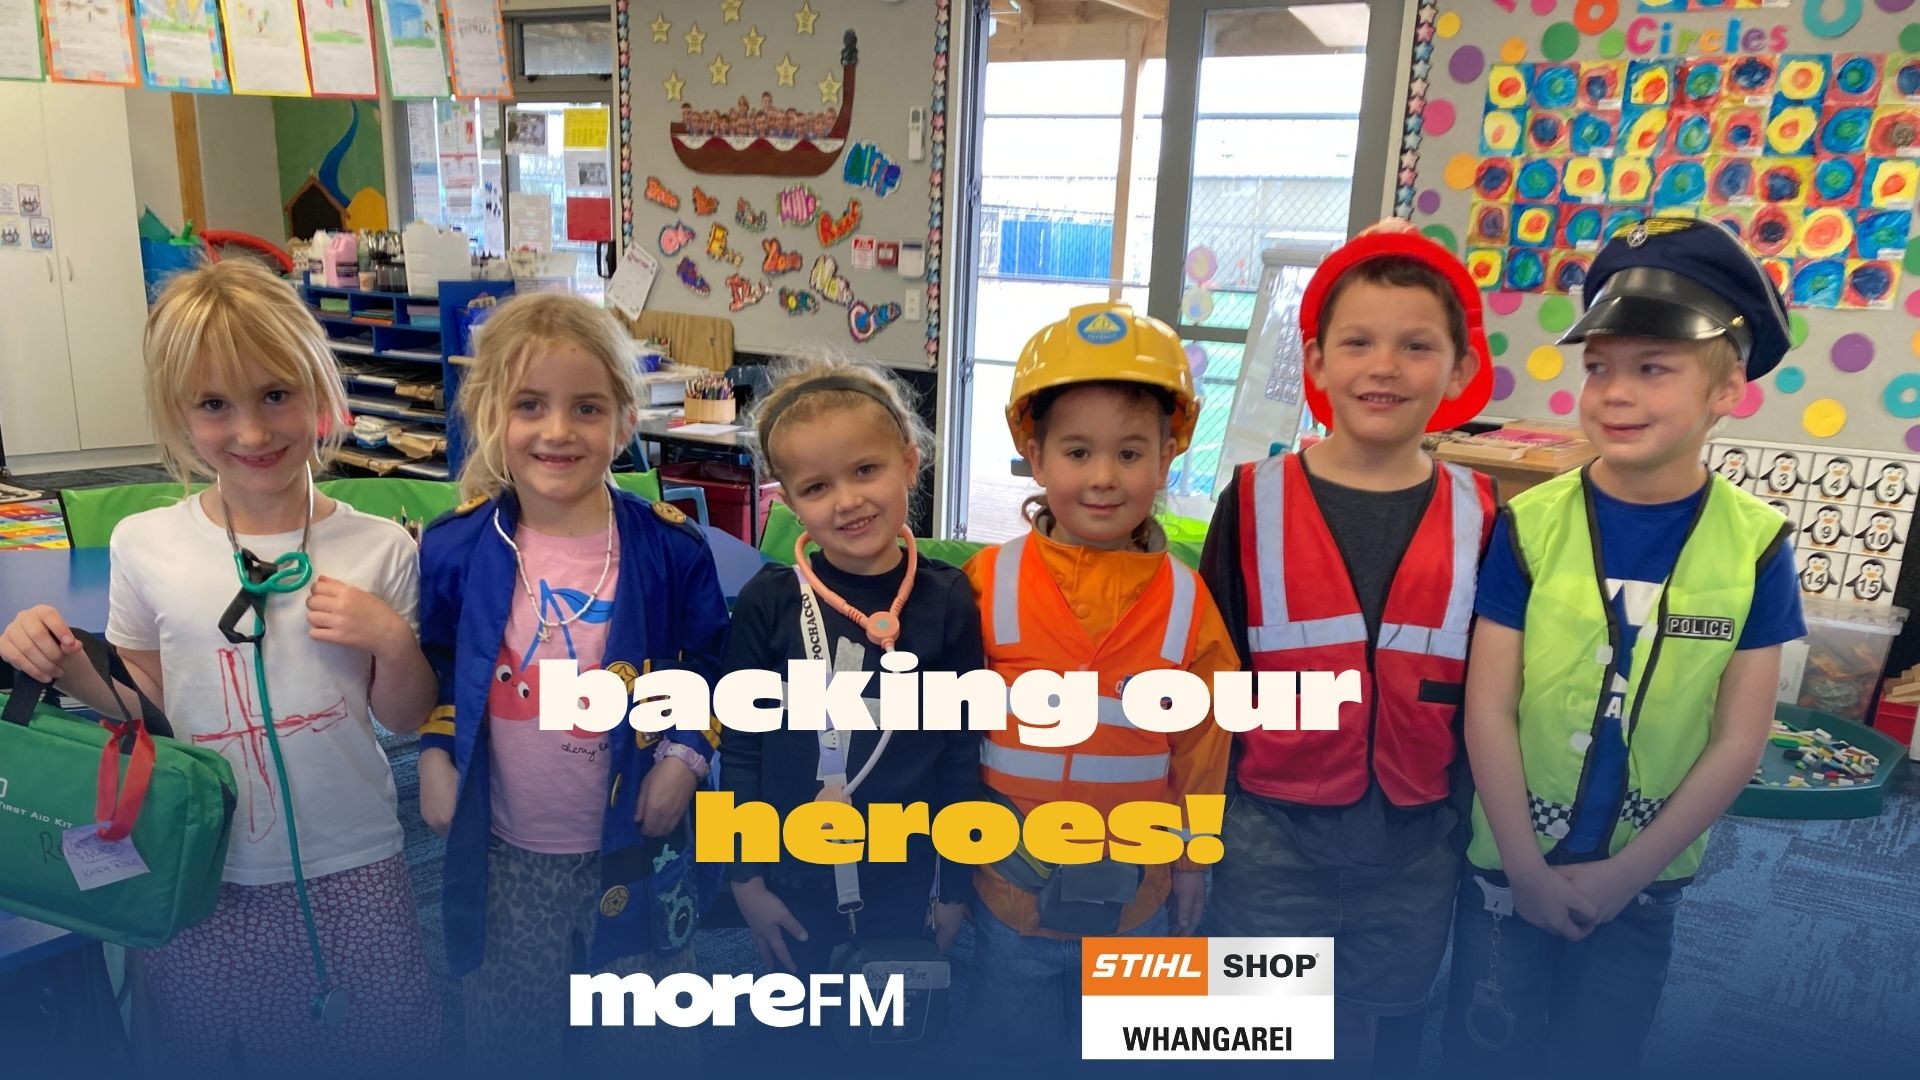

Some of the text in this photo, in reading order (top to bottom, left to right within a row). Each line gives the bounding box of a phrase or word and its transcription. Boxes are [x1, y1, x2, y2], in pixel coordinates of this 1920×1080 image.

[1625, 16, 1789, 55] Circles
[1727, 468, 1738, 482] 2
[1779, 473, 1790, 487] 3
[1830, 479, 1842, 492] 4
[1886, 484, 1897, 497] 5
[1822, 525, 1832, 539] 9
[1868, 531, 1889, 546] 10
[1806, 572, 1825, 586] 14
[1859, 579, 1880, 594] 15
[1670, 618, 1733, 636] POLICE
